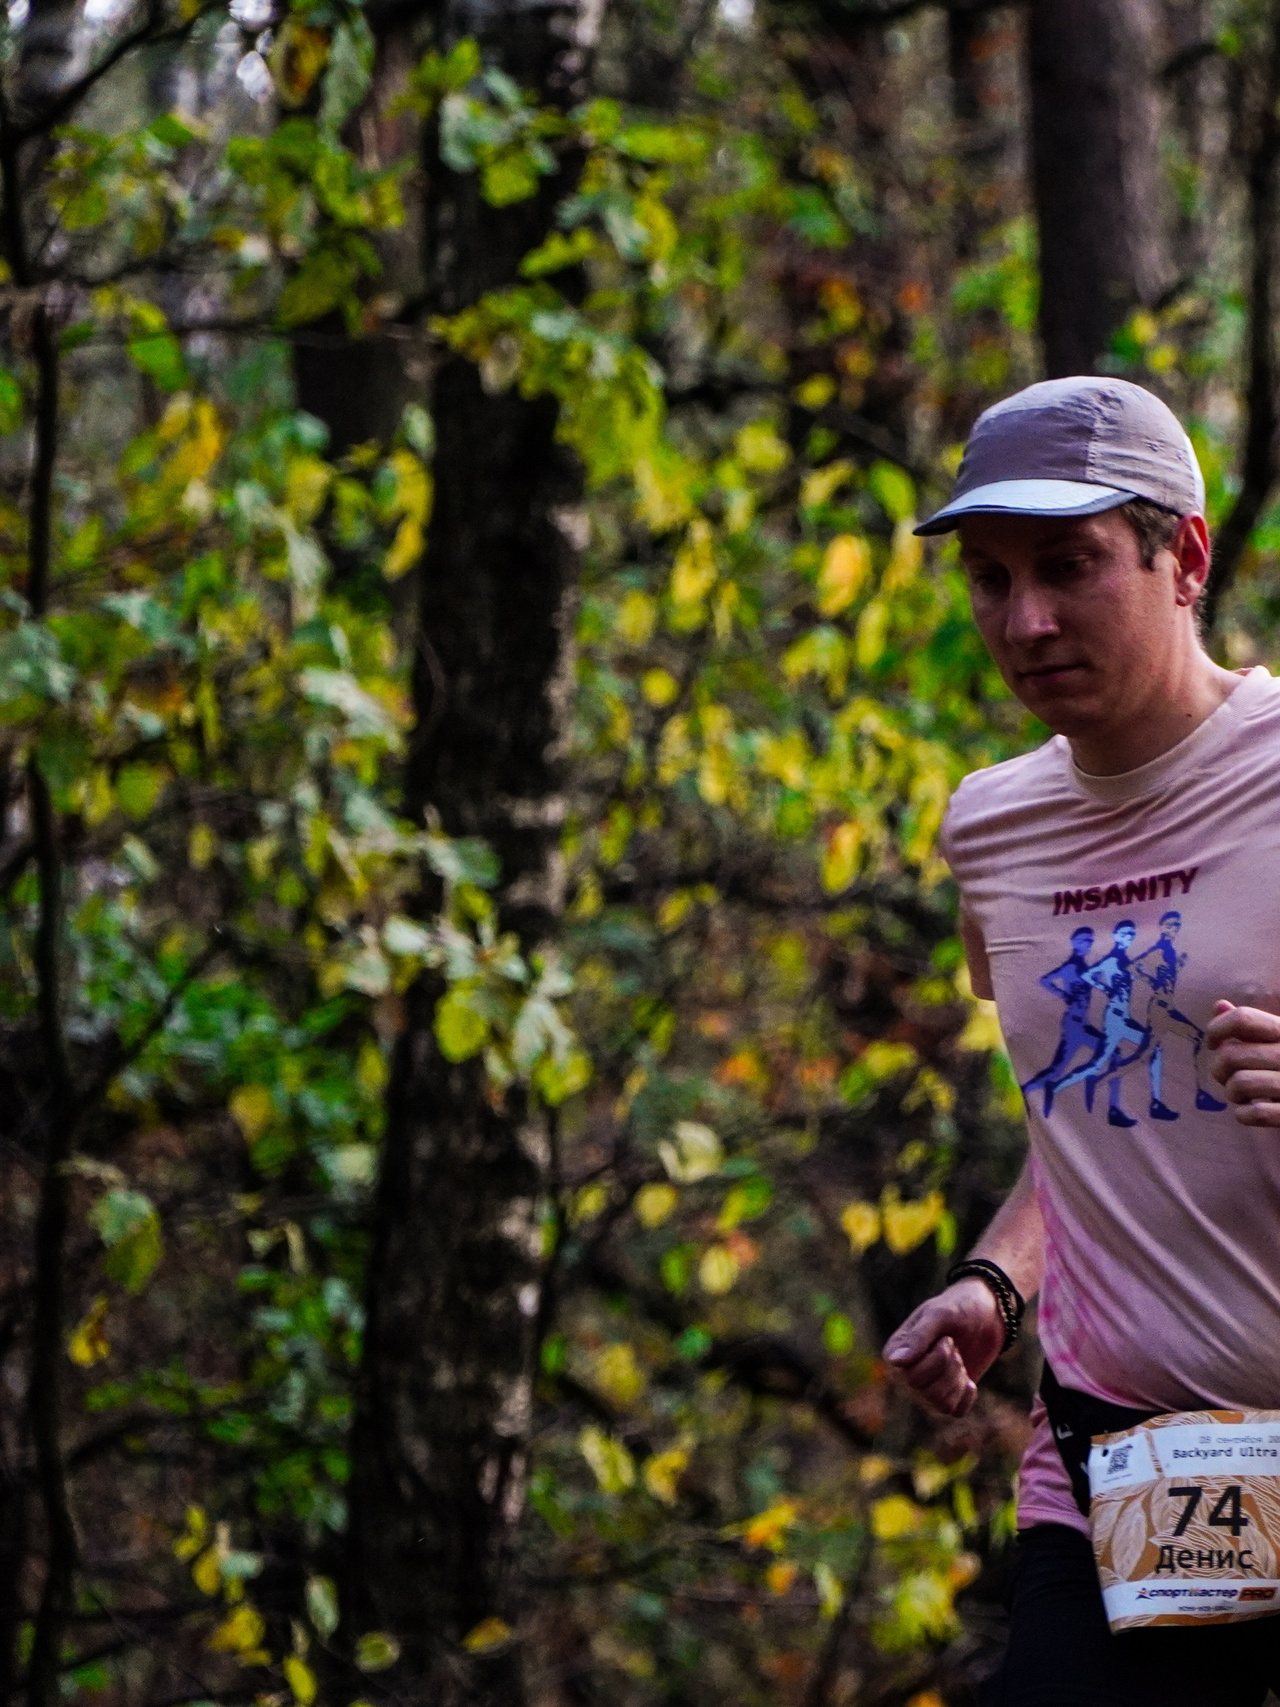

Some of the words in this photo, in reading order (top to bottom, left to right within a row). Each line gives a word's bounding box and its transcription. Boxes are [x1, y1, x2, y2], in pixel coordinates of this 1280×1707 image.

[1052, 866, 1200, 916] INSANITY
[1172, 1446, 1233, 1460] Backyard
[1239, 1446, 1278, 1458] Ultra
[1168, 1485, 1249, 1538] 74
[1155, 1545, 1254, 1575] Денис
